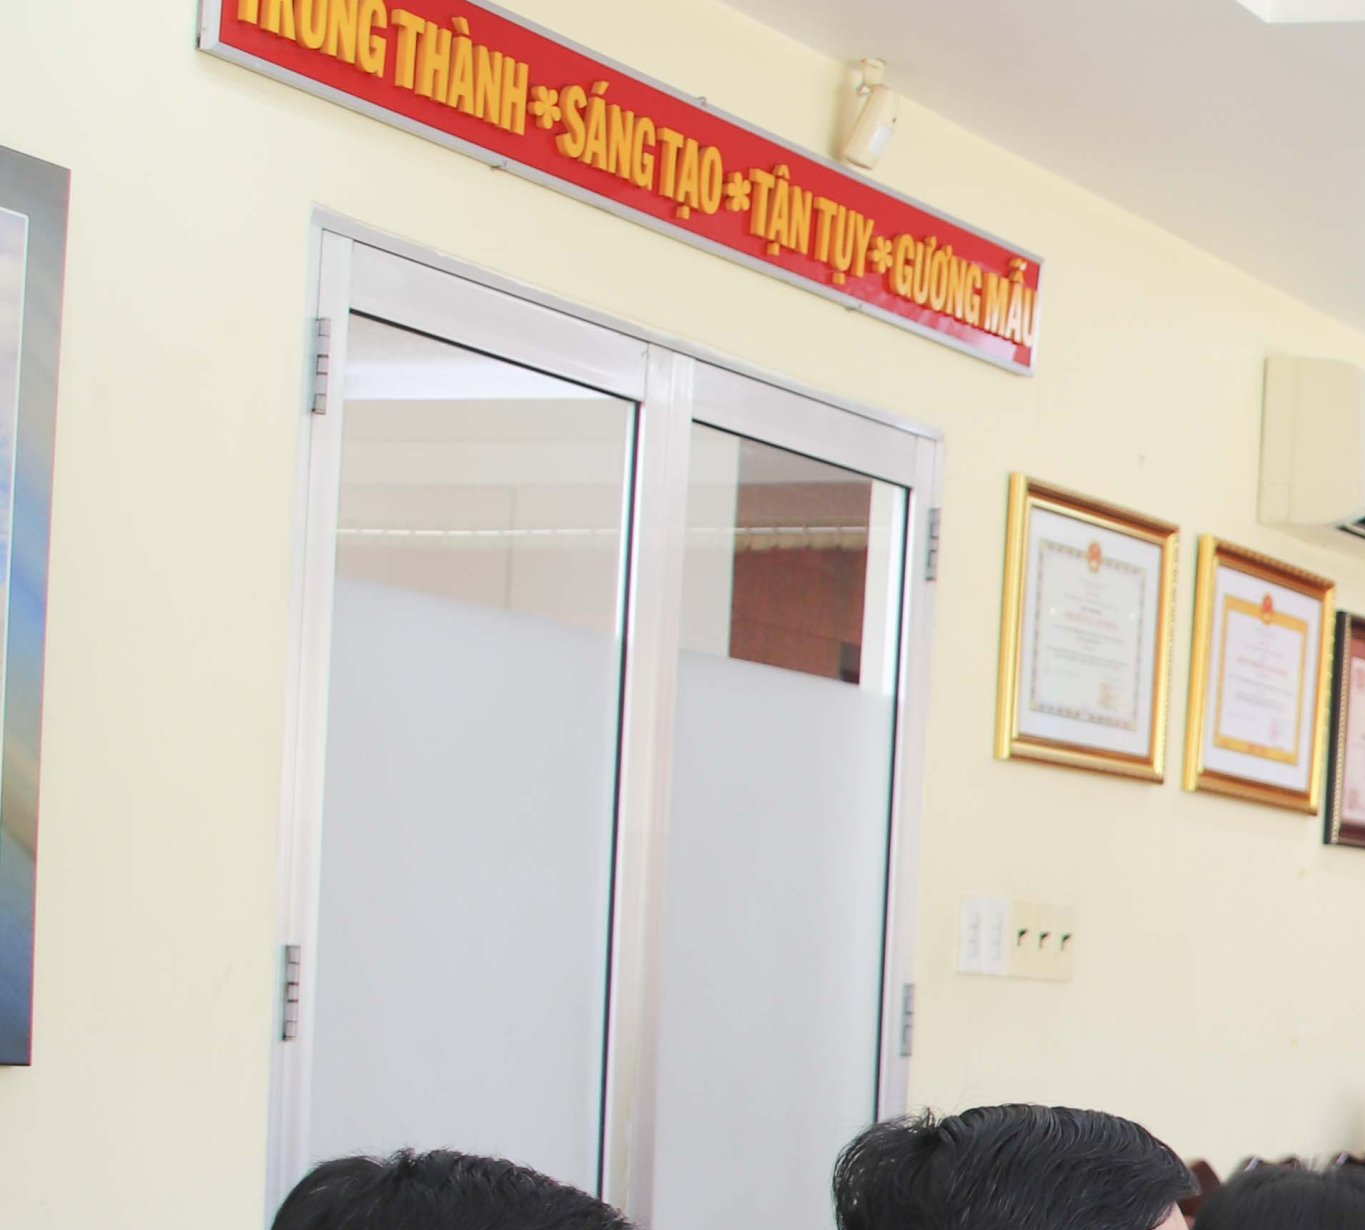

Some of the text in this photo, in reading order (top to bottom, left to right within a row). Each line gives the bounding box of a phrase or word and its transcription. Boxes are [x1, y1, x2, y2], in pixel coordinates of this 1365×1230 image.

[237, 0, 388, 78] UNG
[391, 9, 528, 136] THÀNH
[555, 81, 656, 190] SÁNG
[657, 127, 723, 220] TẠO
[749, 163, 813, 256] TẬN
[814, 196, 875, 285] TỤY
[890, 233, 982, 327] GƯƠNG
